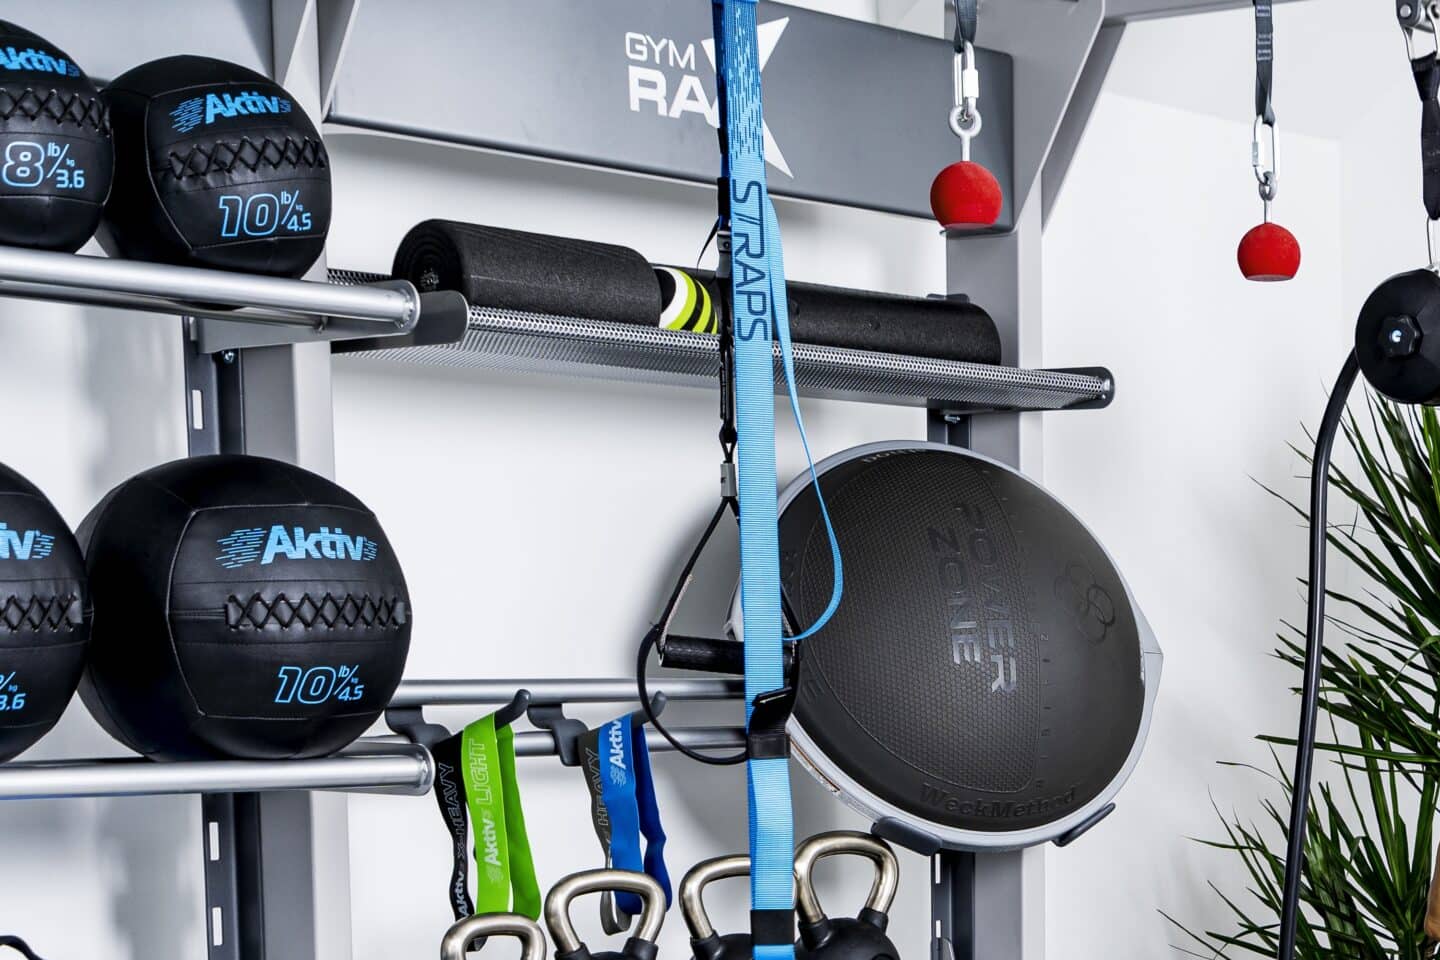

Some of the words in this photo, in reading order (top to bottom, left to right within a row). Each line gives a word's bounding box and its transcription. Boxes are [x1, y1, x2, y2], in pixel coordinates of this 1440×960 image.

[625, 31, 696, 71] GYM
[205, 91, 280, 124] Aktiv
[2, 141, 45, 187] 8
[56, 169, 85, 188] 3.6
[219, 193, 280, 237] 10
[287, 213, 312, 232] 4.5
[260, 524, 364, 565] Aktiv
[927, 527, 981, 665] ZONE
[957, 504, 1017, 693] POWER
[275, 666, 337, 704] 10
[338, 685, 364, 701] 4.5
[609, 719, 626, 769] Aktiv
[469, 738, 493, 805] LIGHT
[483, 817, 503, 867] Aktiv
